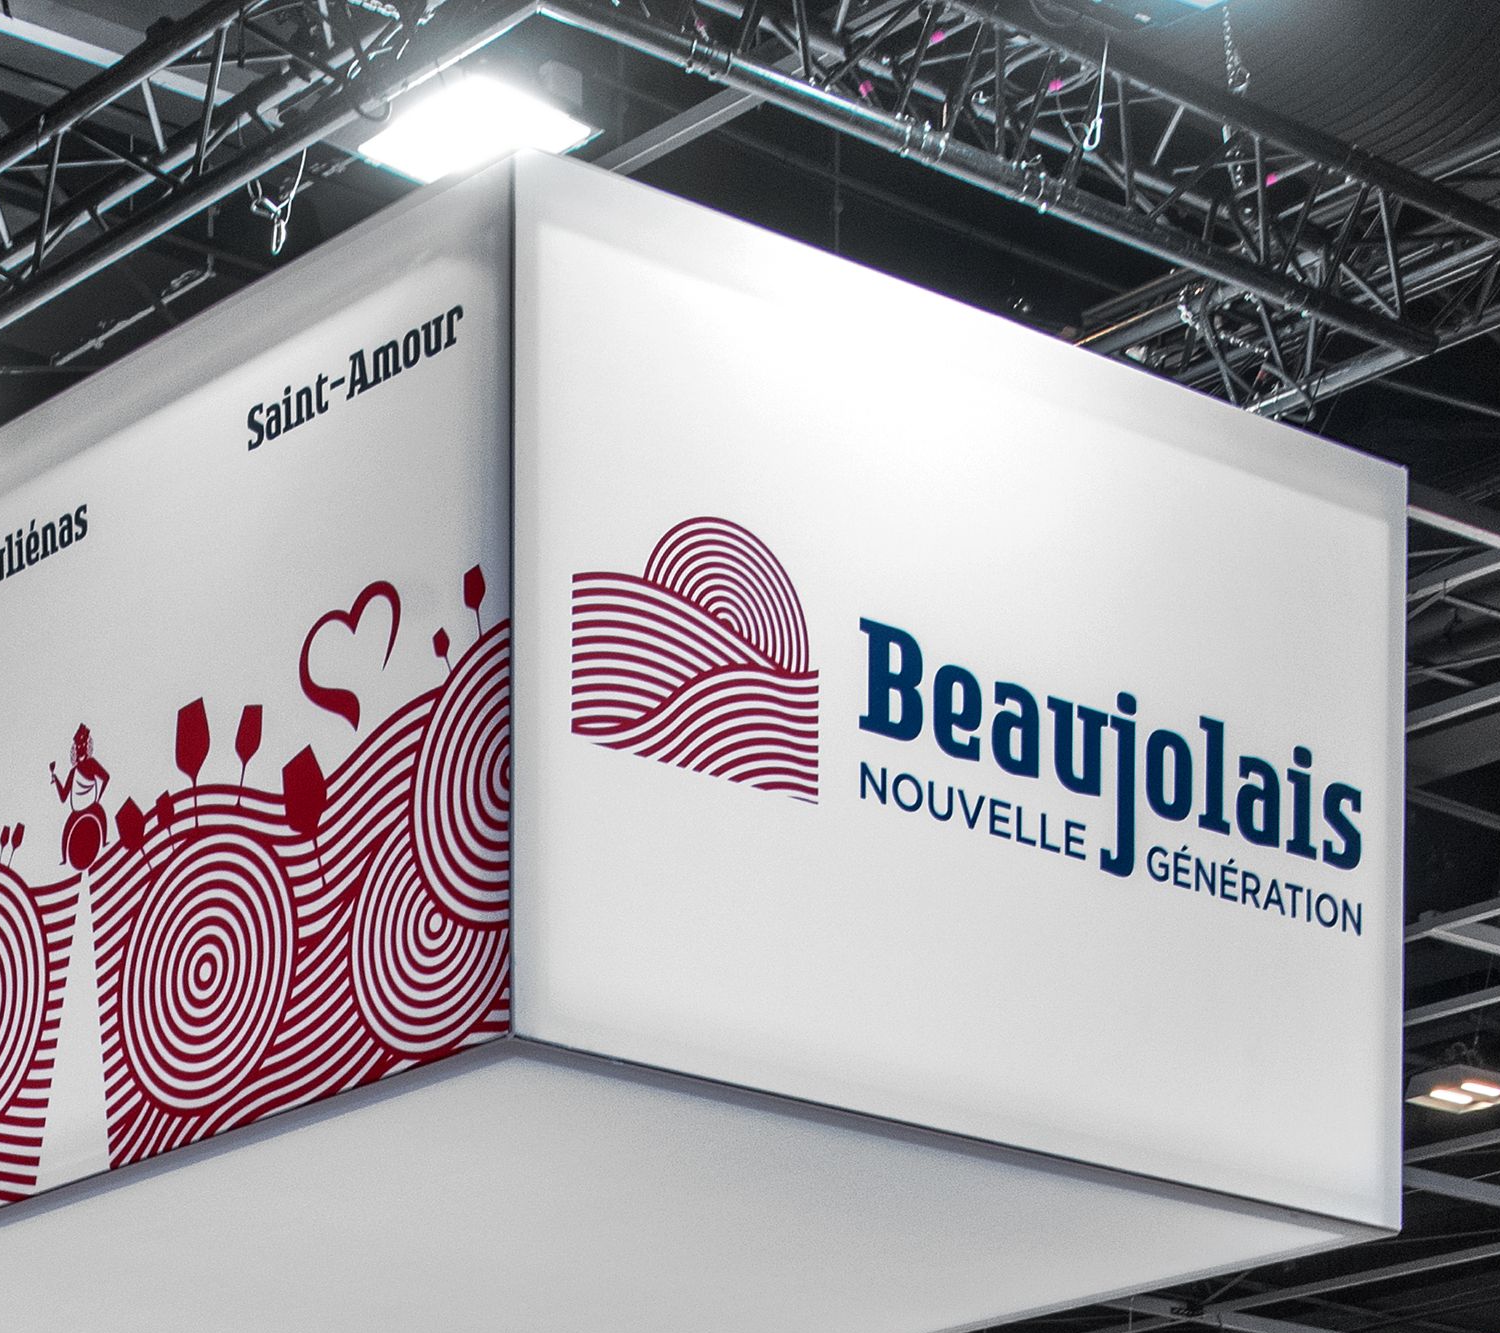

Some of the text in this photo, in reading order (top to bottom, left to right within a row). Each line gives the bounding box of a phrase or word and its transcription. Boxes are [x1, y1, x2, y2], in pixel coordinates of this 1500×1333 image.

[247, 304, 463, 450] Saint-Amour
[859, 617, 1363, 877] Beaujolais
[859, 761, 1364, 937] NOUVELLE GÉNÉRATION
